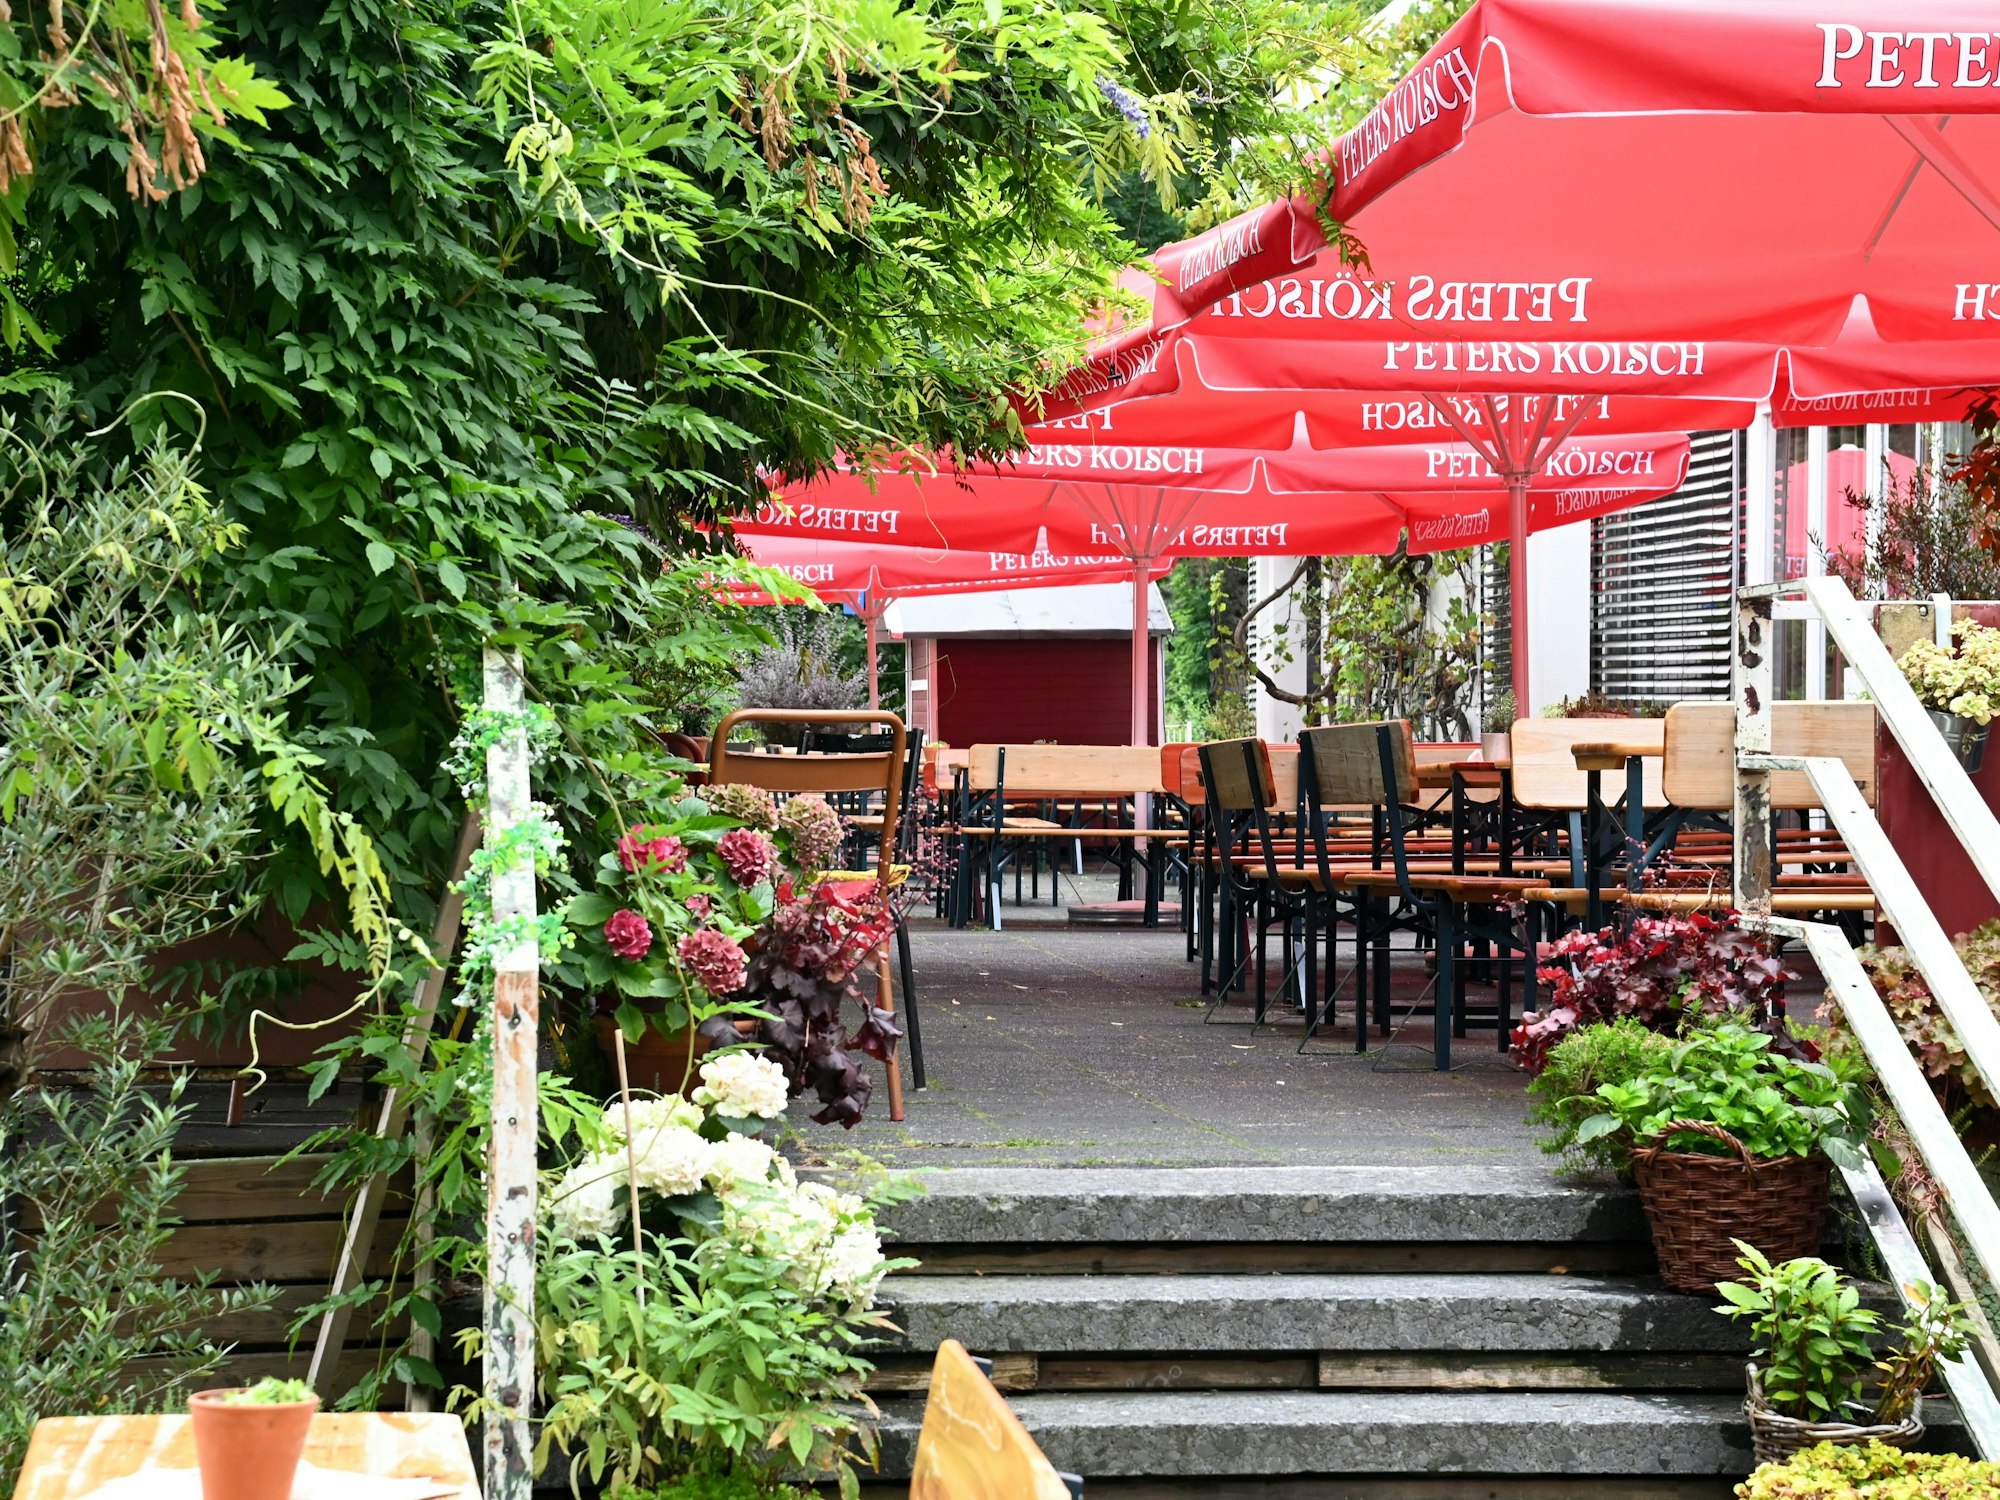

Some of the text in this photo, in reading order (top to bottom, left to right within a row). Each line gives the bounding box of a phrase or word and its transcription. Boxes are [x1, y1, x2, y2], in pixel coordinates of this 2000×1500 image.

[1815, 23, 2000, 88] PETE
[1383, 341, 1541, 373] PETERS
[1425, 447, 1655, 477] PET KÖLSCH
